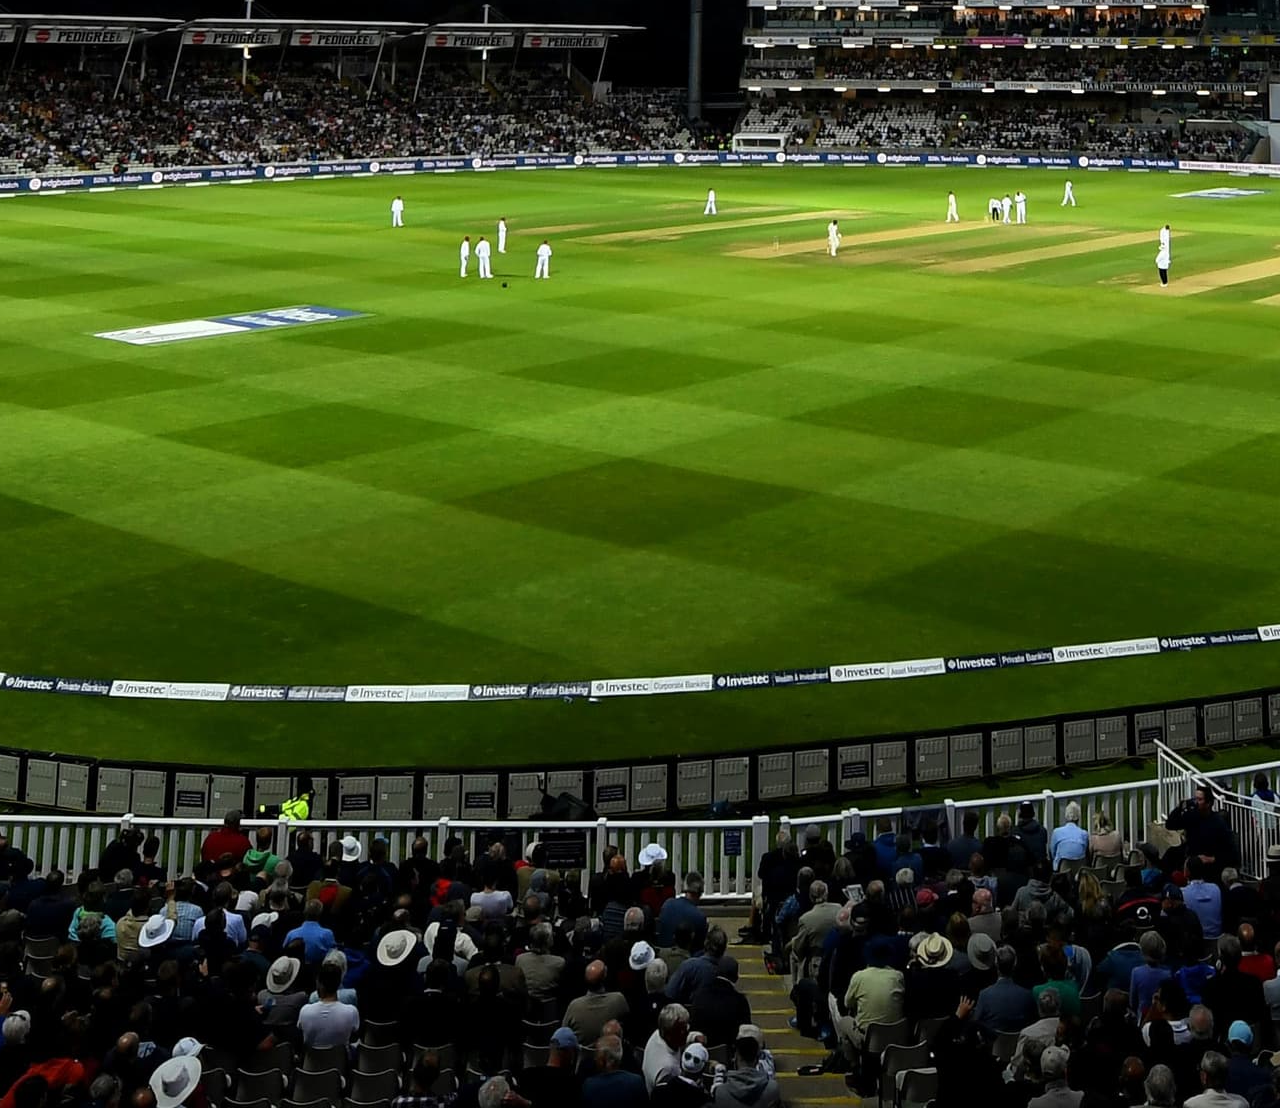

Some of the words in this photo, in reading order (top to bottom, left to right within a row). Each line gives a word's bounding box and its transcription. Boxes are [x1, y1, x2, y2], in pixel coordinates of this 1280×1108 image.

[58, 31, 116, 42] PEDIGREE
[213, 33, 269, 43] PEDIGREE
[318, 34, 371, 44] PEDIGREE
[163, 171, 202, 182] edgbaston
[41, 177, 84, 189] edgbaston
[1169, 636, 1206, 648] Investec
[1066, 646, 1104, 659] Investec
[1109, 644, 1135, 654] Corporate
[1136, 642, 1158, 653] Banking
[957, 657, 996, 669] Investec
[1002, 654, 1025, 664] Private
[1026, 651, 1053, 662] Banking
[844, 666, 885, 678] Investec
[891, 667, 906, 676] Asset
[907, 662, 943, 674] Management
[15, 677, 53, 690] Investec
[57, 681, 80, 692] Private
[605, 681, 648, 692] Investec
[653, 681, 683, 691] Corporate
[684, 679, 710, 690] Banking
[727, 675, 769, 687] Investec
[124, 683, 166, 695] Investec
[240, 686, 285, 698] Investec
[359, 687, 404, 699] Investec
[483, 685, 526, 697] Investec
